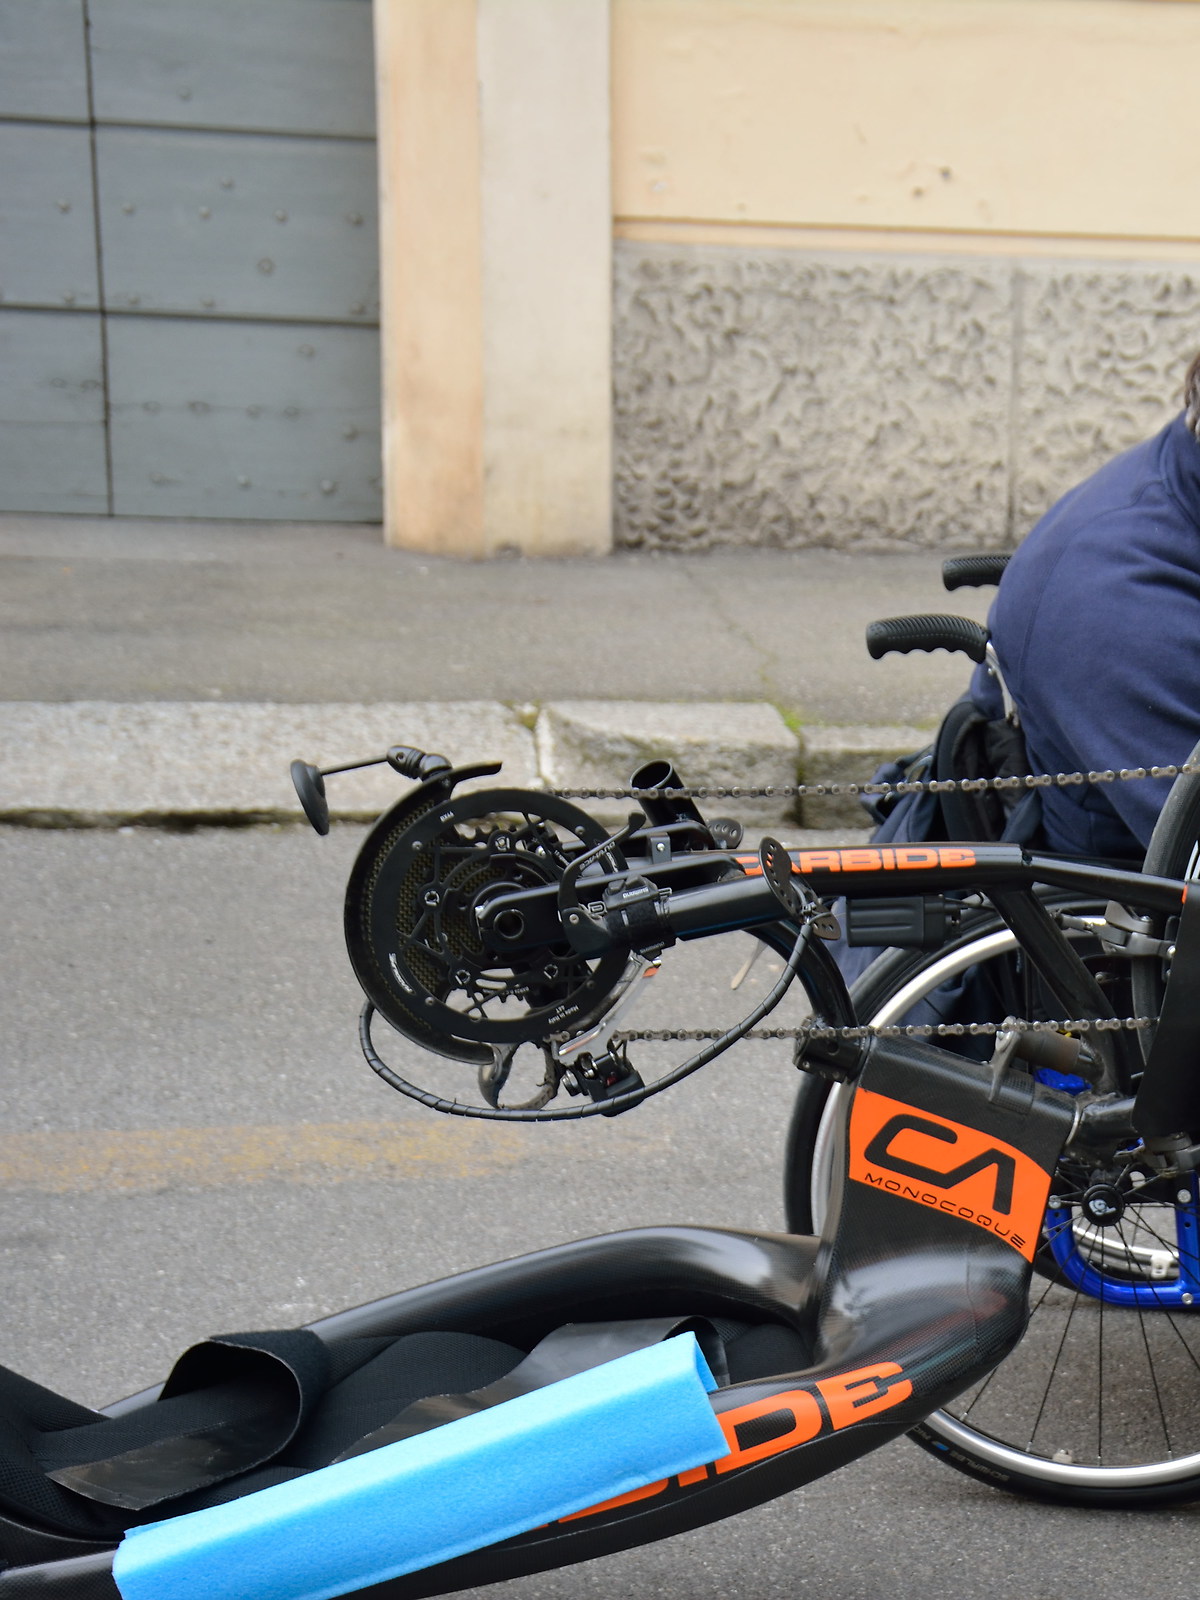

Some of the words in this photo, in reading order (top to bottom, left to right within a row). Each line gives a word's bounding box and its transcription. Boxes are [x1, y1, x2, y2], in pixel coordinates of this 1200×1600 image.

[736, 847, 977, 876] CRBIDE
[864, 1113, 1016, 1216] CA
[864, 1172, 1027, 1250] MONOCOQUE
